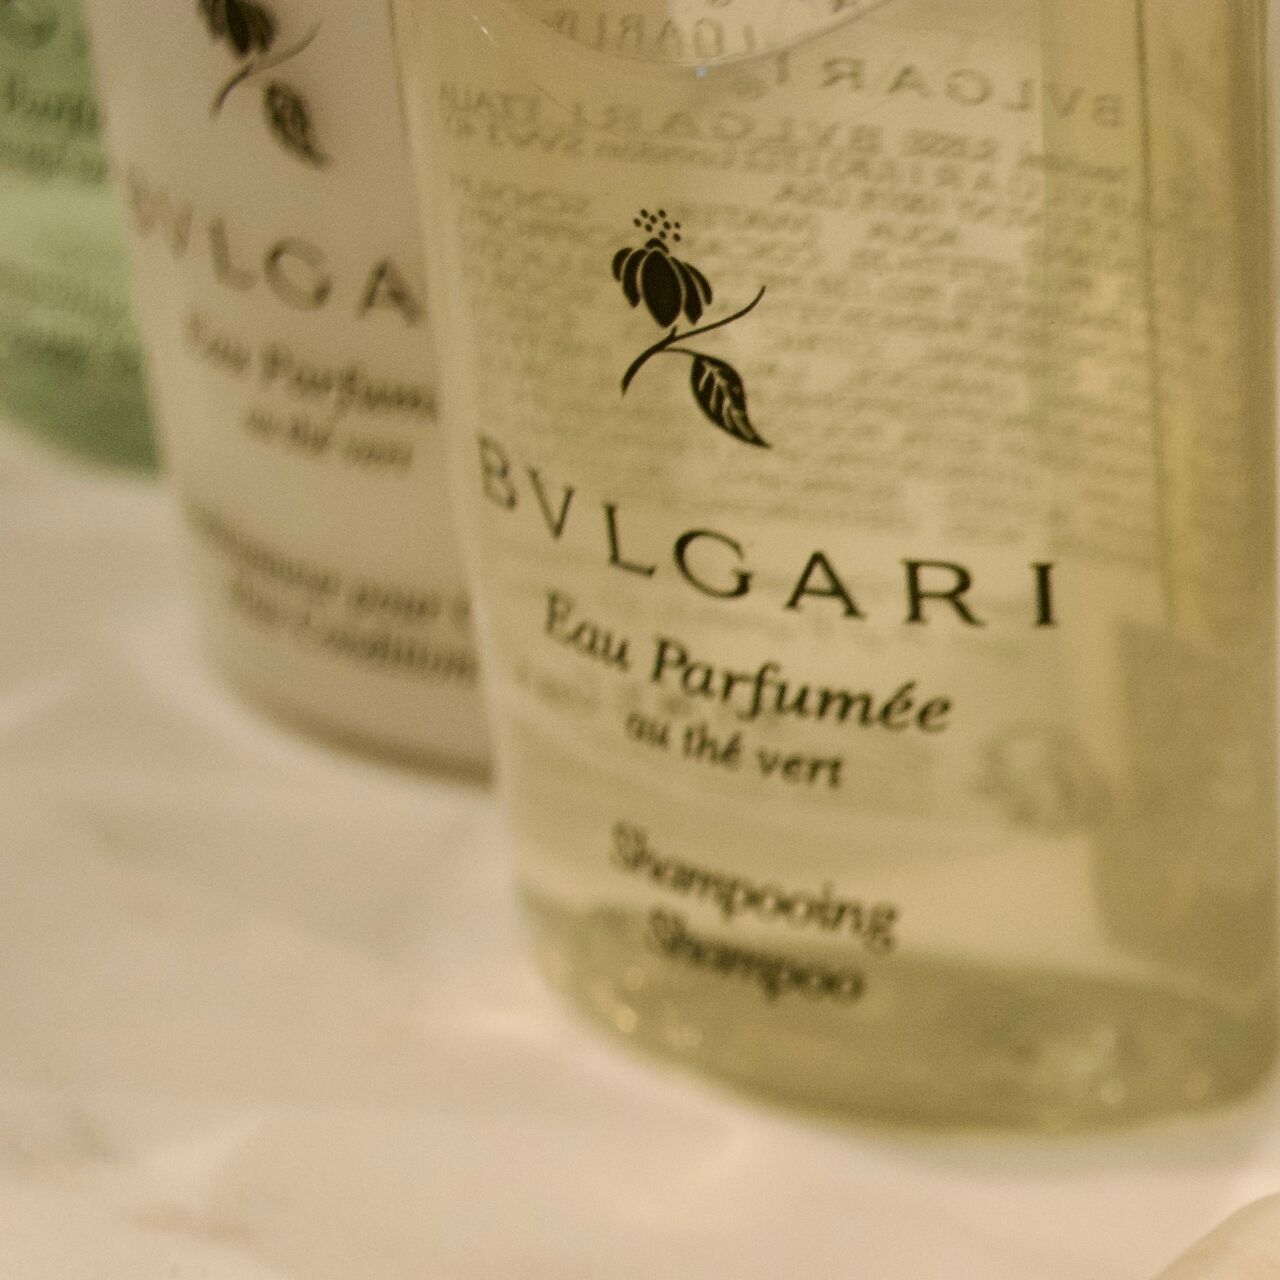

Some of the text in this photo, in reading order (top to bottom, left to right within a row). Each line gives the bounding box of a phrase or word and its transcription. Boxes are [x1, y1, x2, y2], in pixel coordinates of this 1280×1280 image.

[126, 166, 428, 328] BVLGA
[477, 432, 1058, 627] BVLGARI
[545, 590, 630, 672] Eau
[651, 632, 953, 736] Parfumée
[625, 711, 844, 791] au thé vert
[611, 822, 903, 955] Shampooing
[648, 908, 866, 1003] Shampoo
